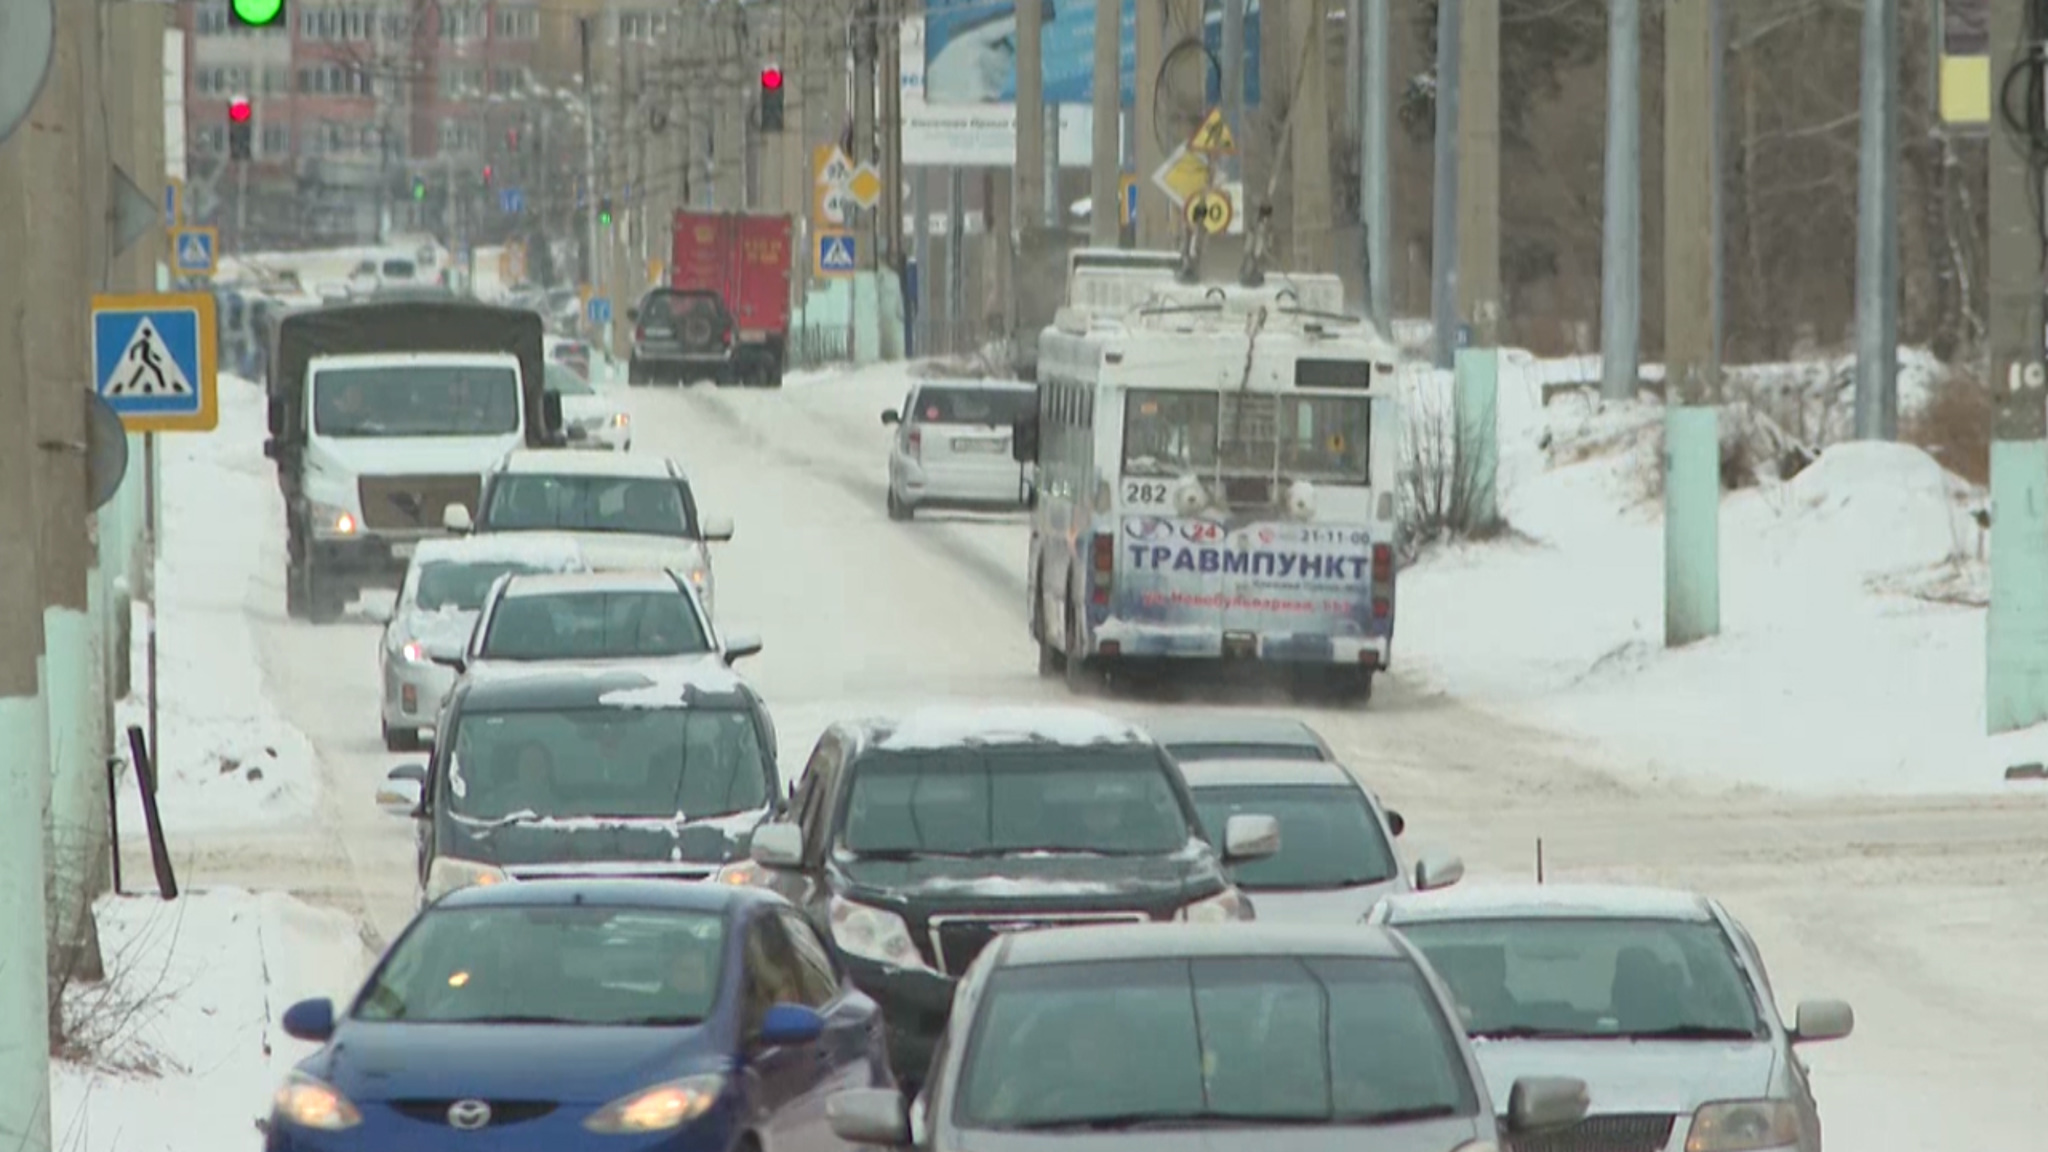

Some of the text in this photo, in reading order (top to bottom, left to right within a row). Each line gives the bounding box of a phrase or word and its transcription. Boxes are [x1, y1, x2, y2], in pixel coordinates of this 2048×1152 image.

[1192, 202, 1222, 221] 0
[1127, 484, 1167, 504] 282
[1193, 521, 1217, 542] 24
[1129, 544, 1369, 580] ТРАВМПУНКТ
